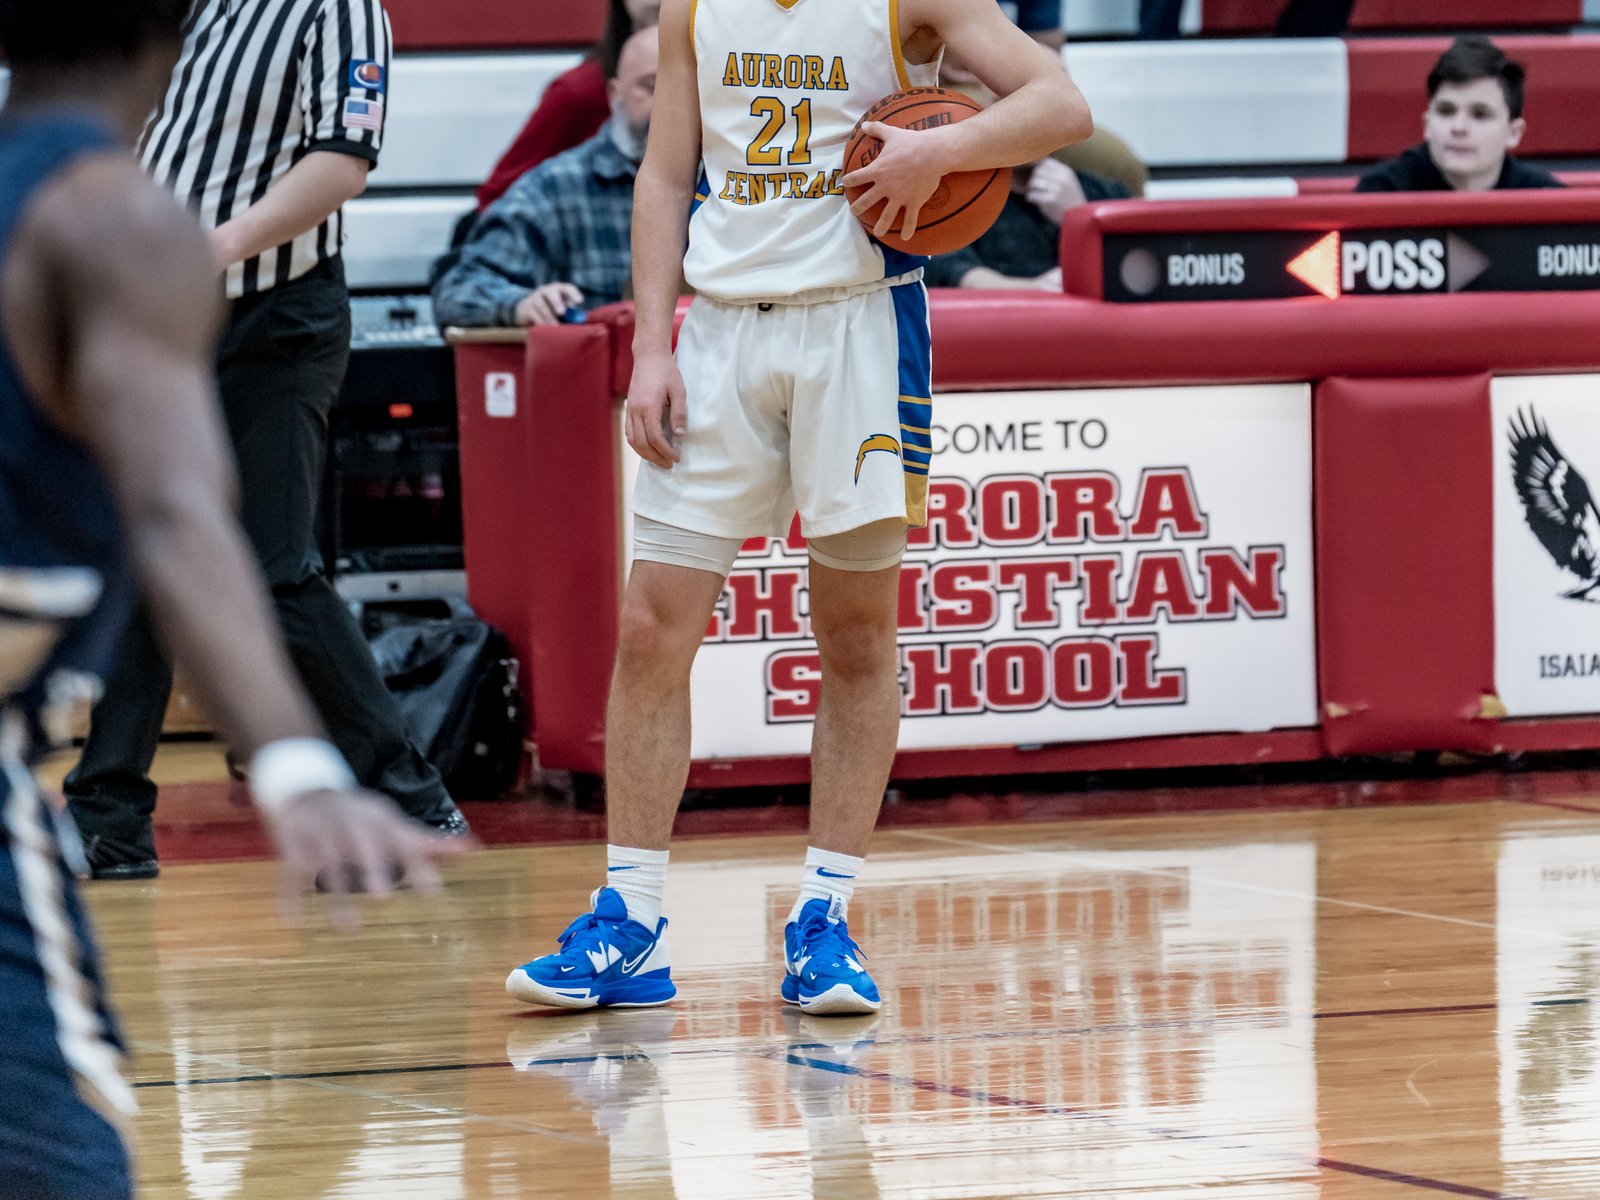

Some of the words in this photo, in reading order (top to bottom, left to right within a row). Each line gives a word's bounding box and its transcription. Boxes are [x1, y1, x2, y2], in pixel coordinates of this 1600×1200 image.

[722, 51, 849, 91] AURORA
[746, 95, 812, 166] 21
[718, 168, 845, 206] CENTRAL
[1167, 252, 1246, 286] BONUS
[1341, 237, 1446, 291] POSS
[1537, 243, 1600, 277] BONU
[931, 420, 1042, 455] COME
[1055, 418, 1108, 450] TO
[702, 544, 1287, 644] HISTIAN
[764, 632, 1188, 725] SHOOL
